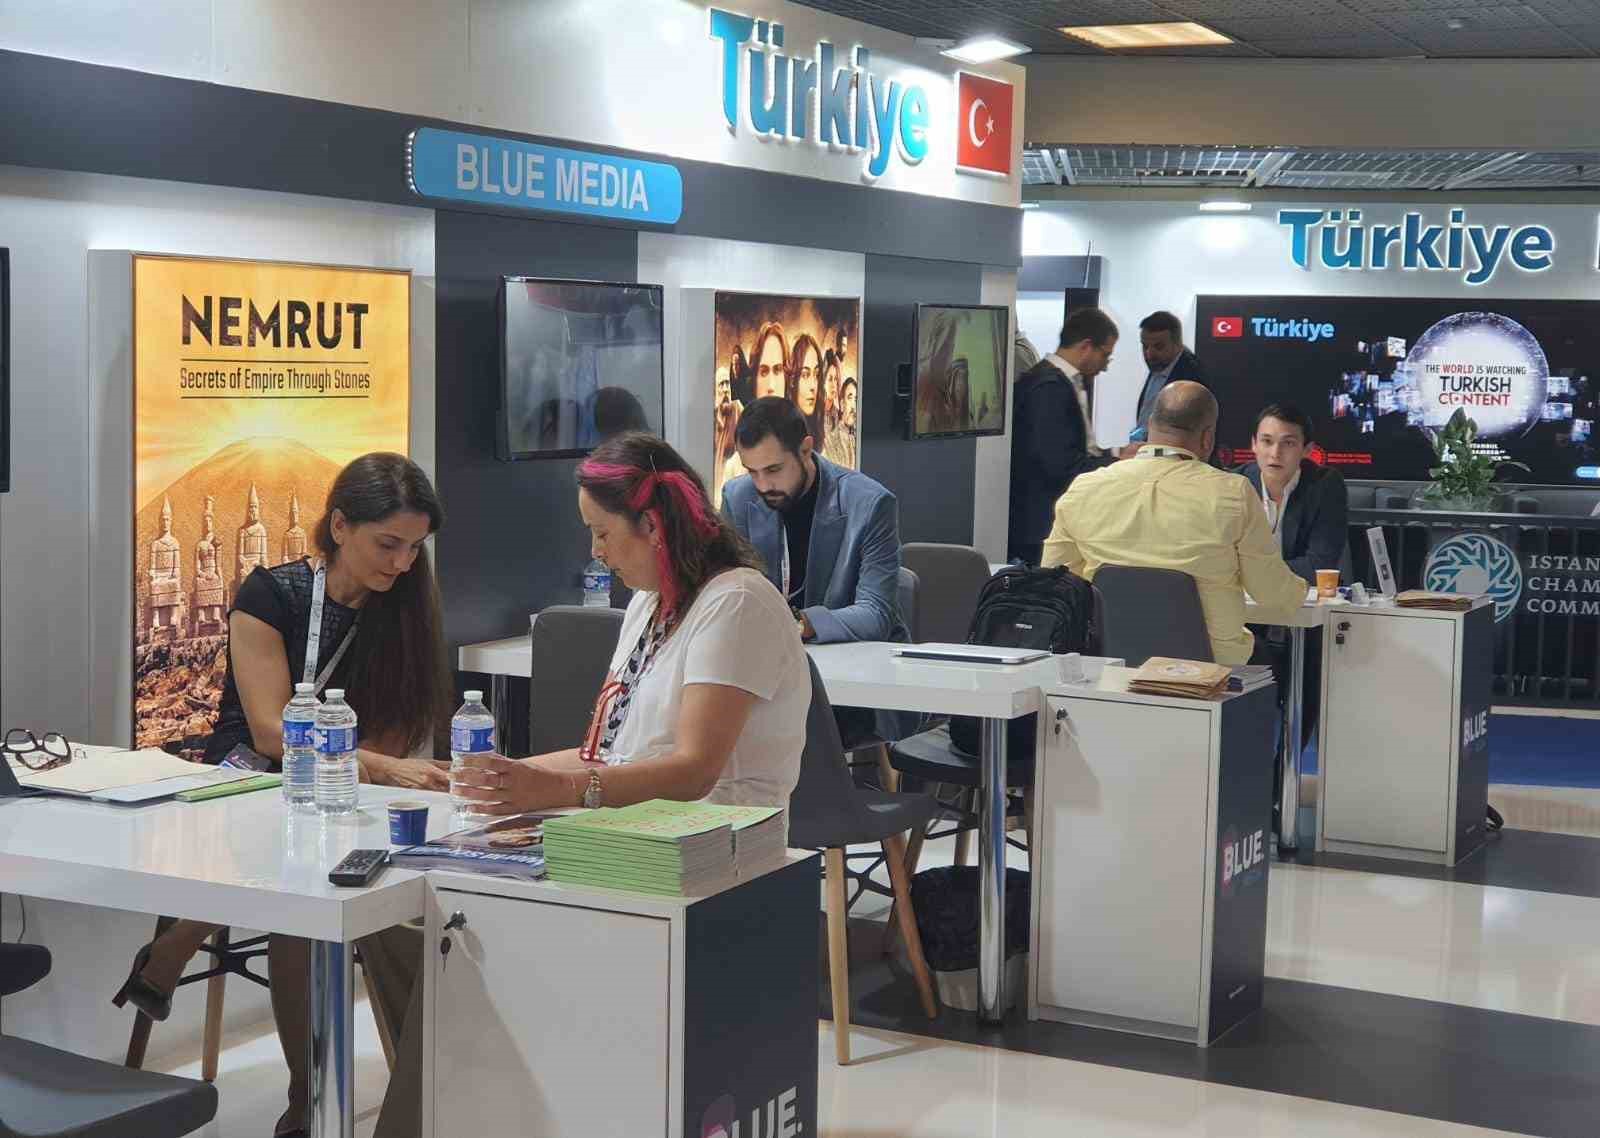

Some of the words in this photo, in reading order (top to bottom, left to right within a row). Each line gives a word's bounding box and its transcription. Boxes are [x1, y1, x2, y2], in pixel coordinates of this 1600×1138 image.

[710, 7, 928, 177] Türkiye
[456, 143, 545, 199] BLUE
[555, 157, 649, 212] MEDIA
[1279, 209, 1553, 284] Türkiye
[182, 294, 369, 349] NEMRUT
[1251, 317, 1335, 341] Türkiye
[180, 367, 226, 389] Secrets
[229, 367, 242, 389] of
[244, 368, 284, 393] Empire
[286, 368, 331, 393] Through
[334, 369, 370, 389] Stones
[1425, 364, 1440, 374] THE
[1443, 364, 1474, 374] WORLD
[1476, 365, 1484, 374] IS
[1486, 366, 1527, 375] WATCHING
[1440, 376, 1512, 393] TURKISH
[1529, 555, 1600, 571] ISTAN
[1528, 576, 1600, 593] CHAM
[1527, 598, 1600, 616] COMM
